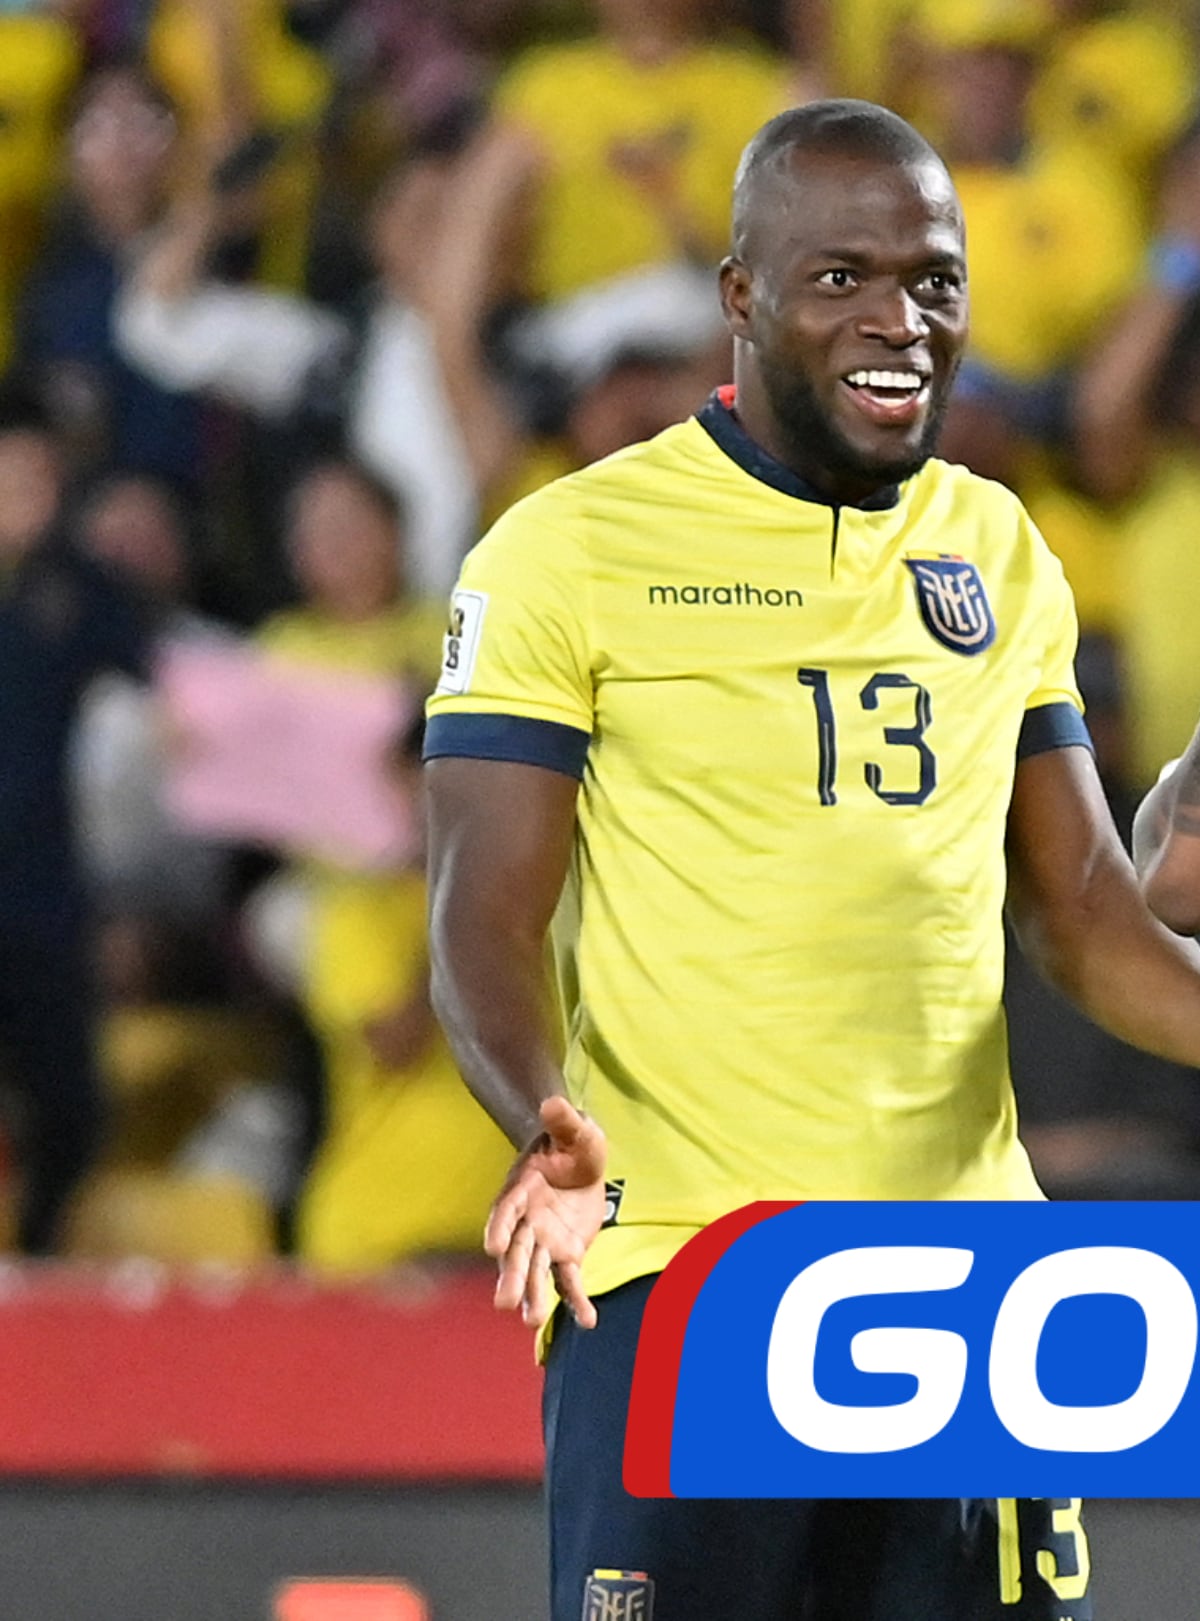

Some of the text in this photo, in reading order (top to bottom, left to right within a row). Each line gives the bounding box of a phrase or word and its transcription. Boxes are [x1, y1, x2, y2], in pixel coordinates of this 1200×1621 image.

[649, 583, 803, 607] marathon
[797, 667, 936, 806] 13
[997, 1498, 1091, 1604] 13
